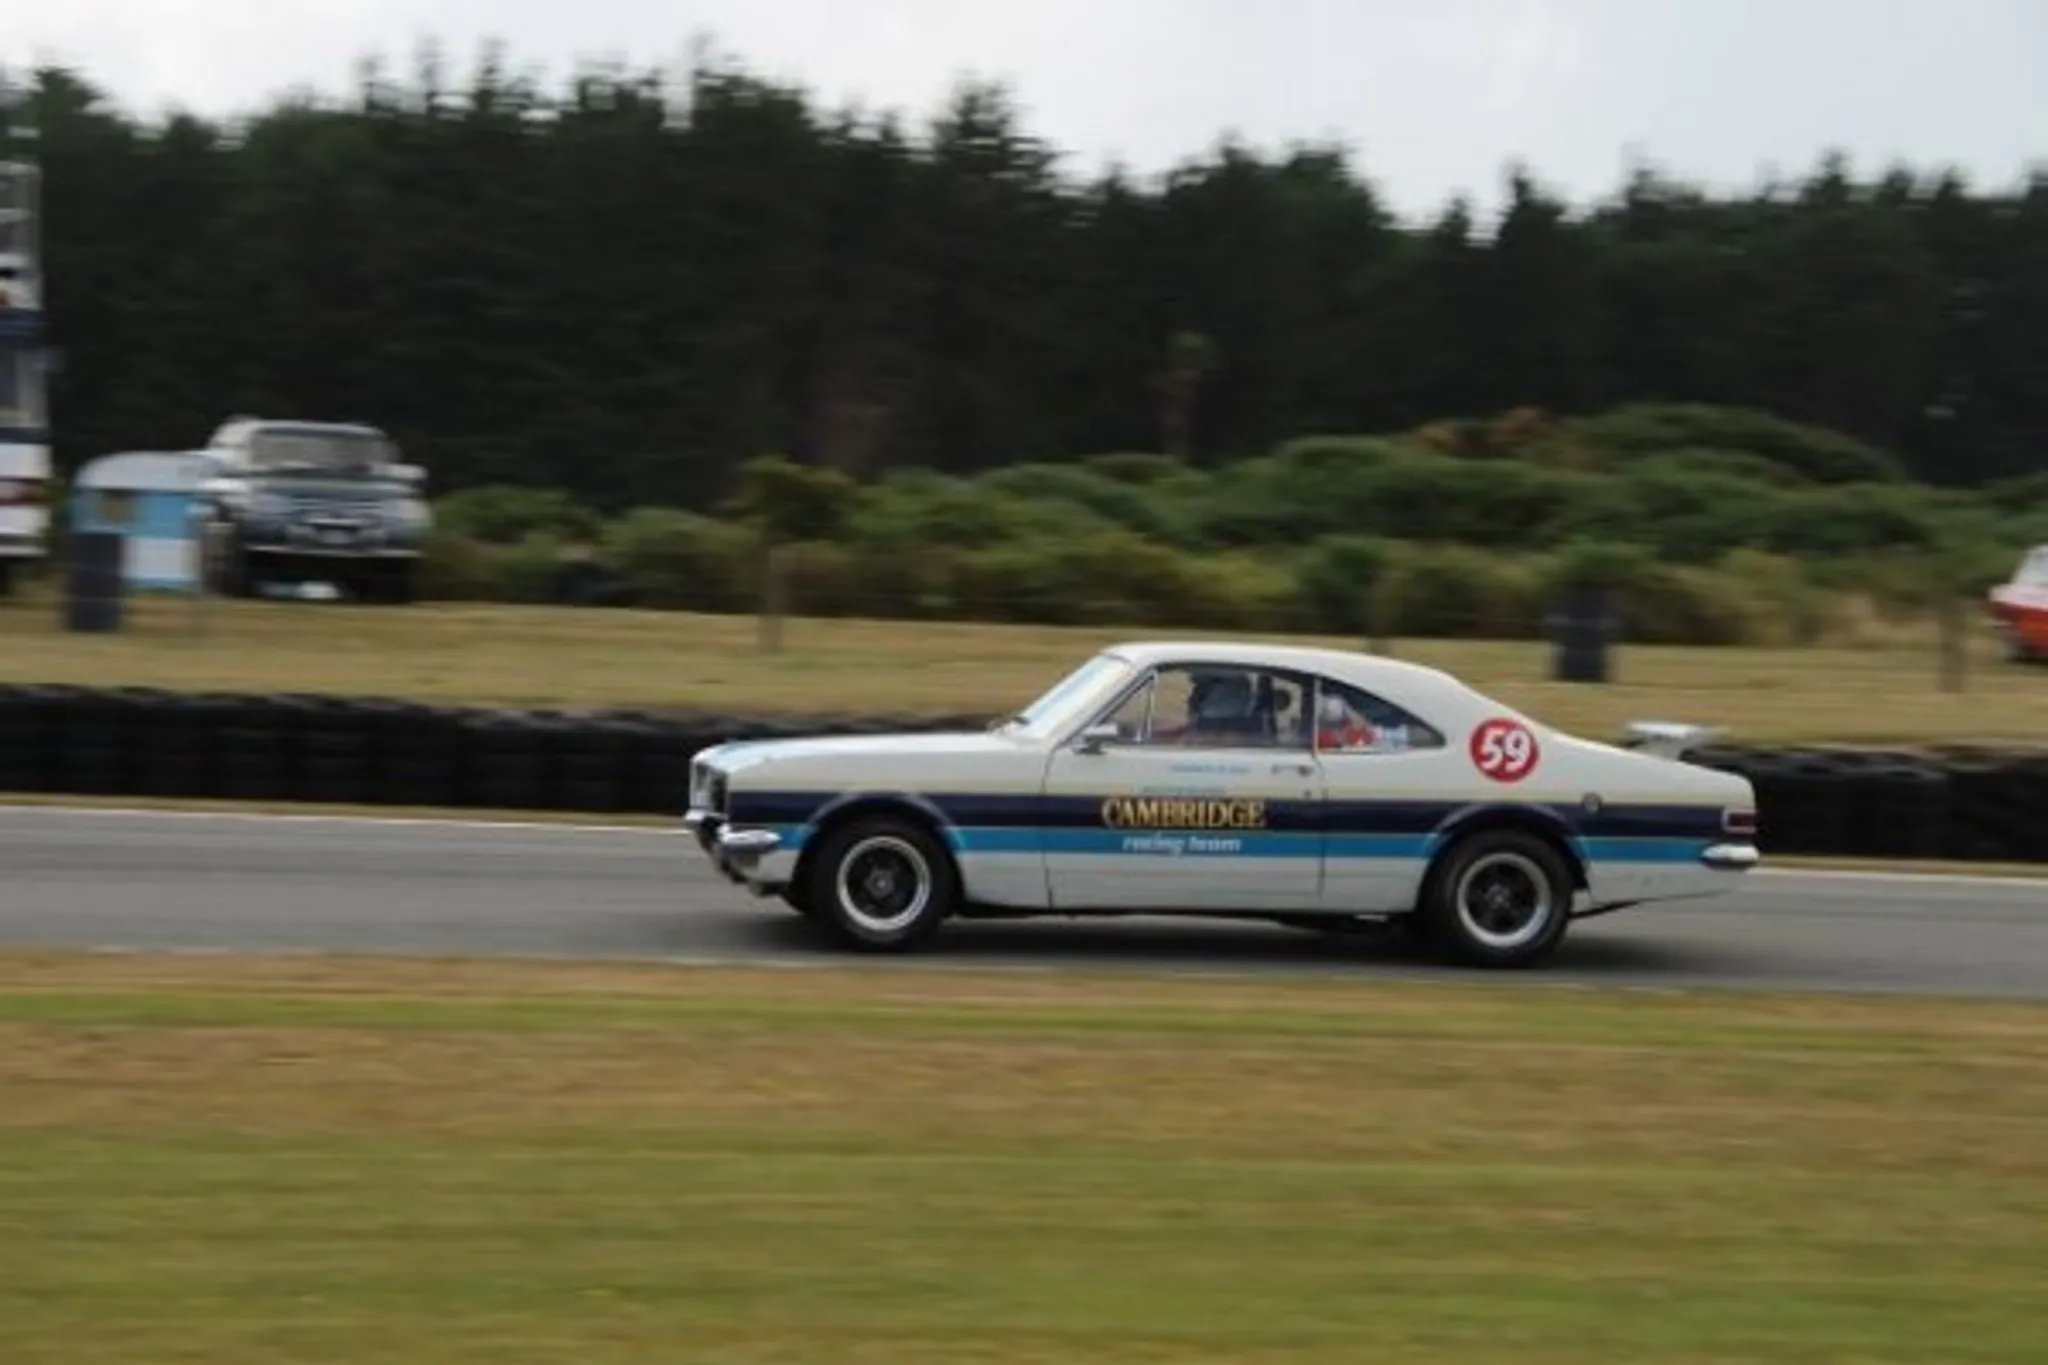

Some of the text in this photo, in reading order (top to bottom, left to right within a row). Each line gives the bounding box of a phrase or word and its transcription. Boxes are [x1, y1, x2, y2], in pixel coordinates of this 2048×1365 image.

[1480, 726, 1531, 771] 59
[1101, 797, 1267, 828] CAMBRIDGE
[1122, 831, 1242, 857] racing team
